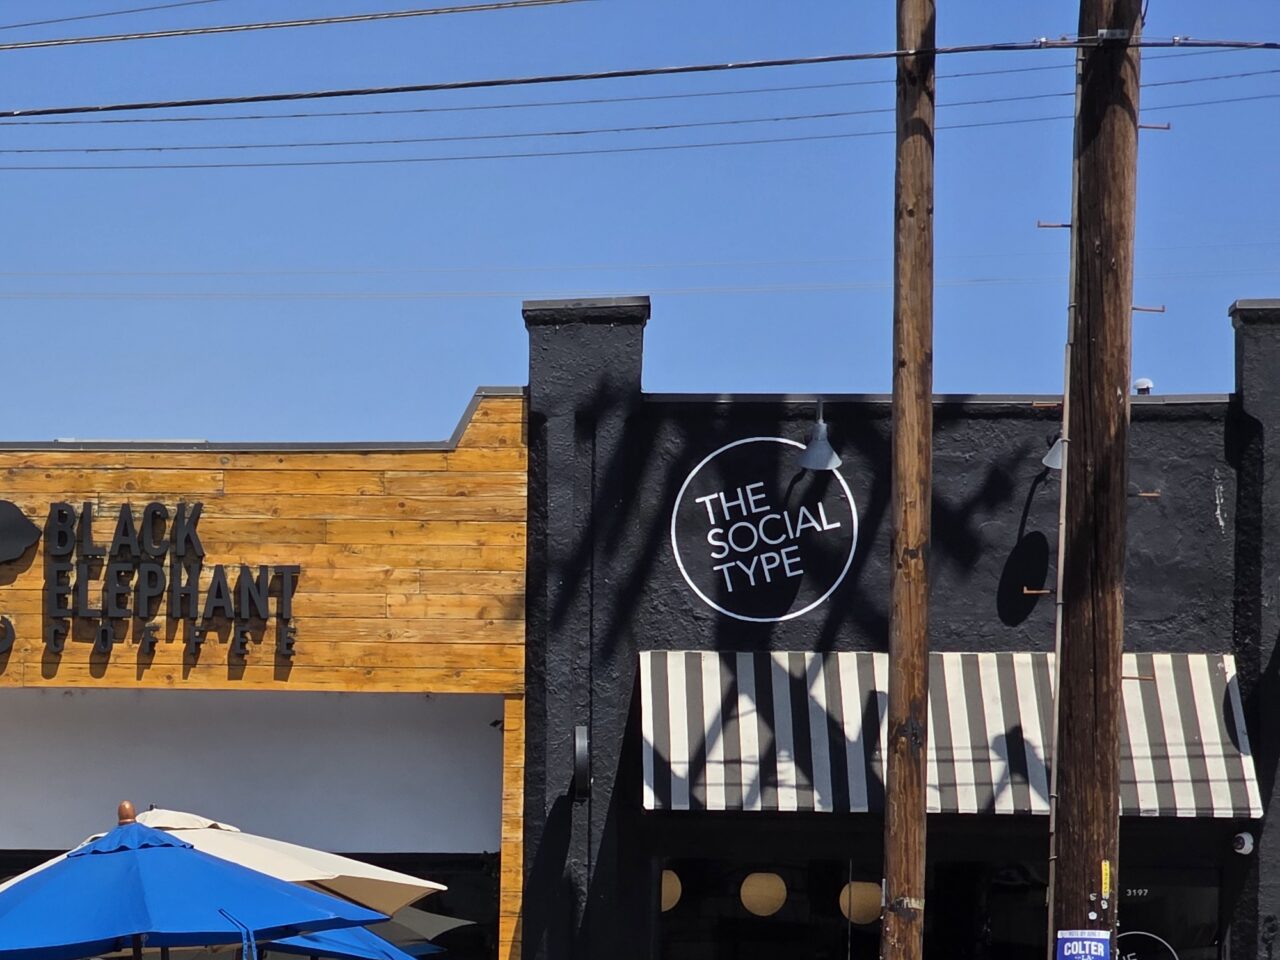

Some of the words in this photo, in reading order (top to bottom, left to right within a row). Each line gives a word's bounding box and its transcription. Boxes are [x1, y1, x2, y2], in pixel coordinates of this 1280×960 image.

[695, 482, 770, 525] THE
[49, 502, 205, 558] BLACK
[707, 501, 841, 559] SOCIAL
[48, 562, 300, 620] ELEPHANT
[712, 545, 804, 592] TYPE
[47, 623, 296, 655] COFFEE
[1064, 940, 1105, 957] COLTER
